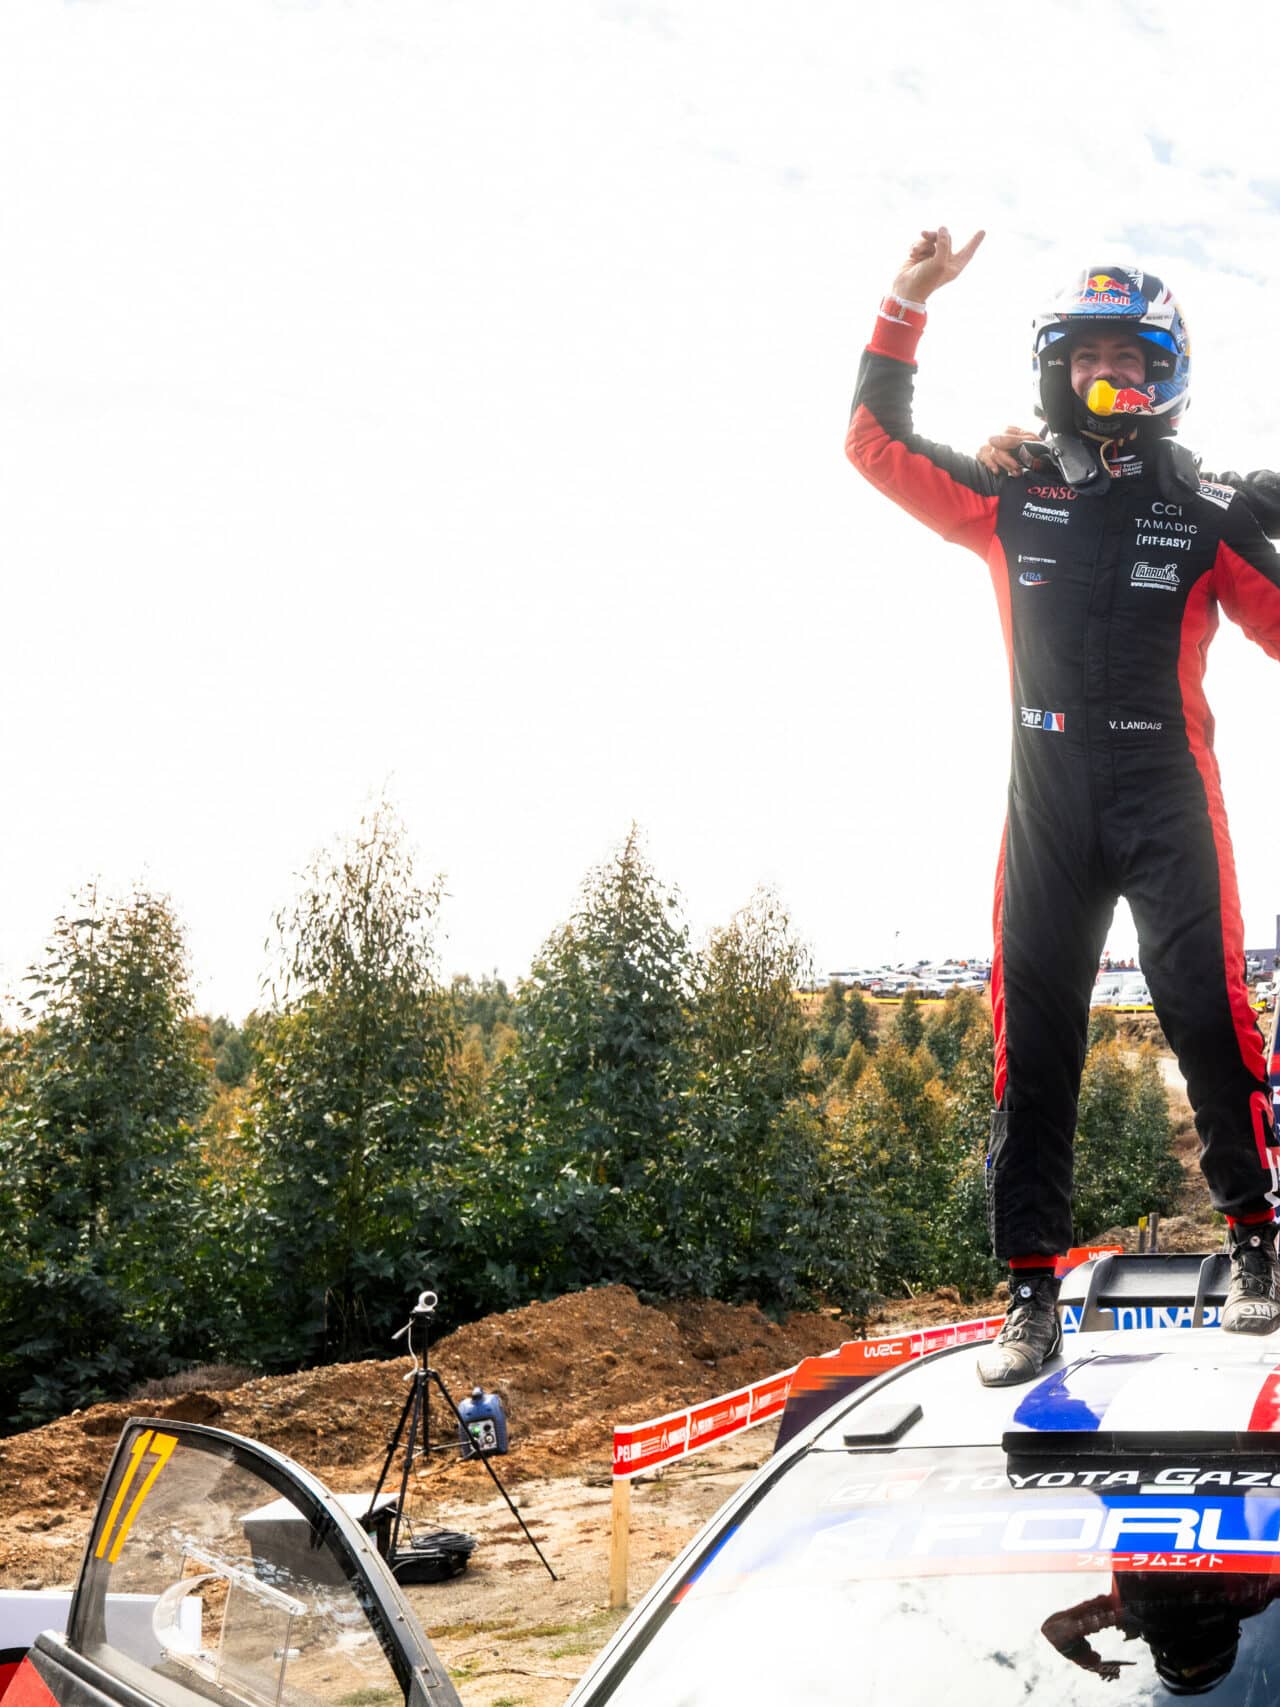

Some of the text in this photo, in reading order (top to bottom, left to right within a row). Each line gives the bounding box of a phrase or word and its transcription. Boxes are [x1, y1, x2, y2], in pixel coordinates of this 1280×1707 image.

[1101, 292, 1130, 305] Bull
[1200, 485, 1233, 501] OMP
[1023, 502, 1070, 518] Panasonic
[1151, 502, 1182, 516] CCI
[1022, 511, 1070, 525] AUTOMOTIVE
[1108, 720, 1118, 730] V.
[938, 1470, 1138, 1491] TOYOTA
[95, 1429, 179, 1564] 17
[1077, 1553, 1224, 1567] フォーラムエイト
